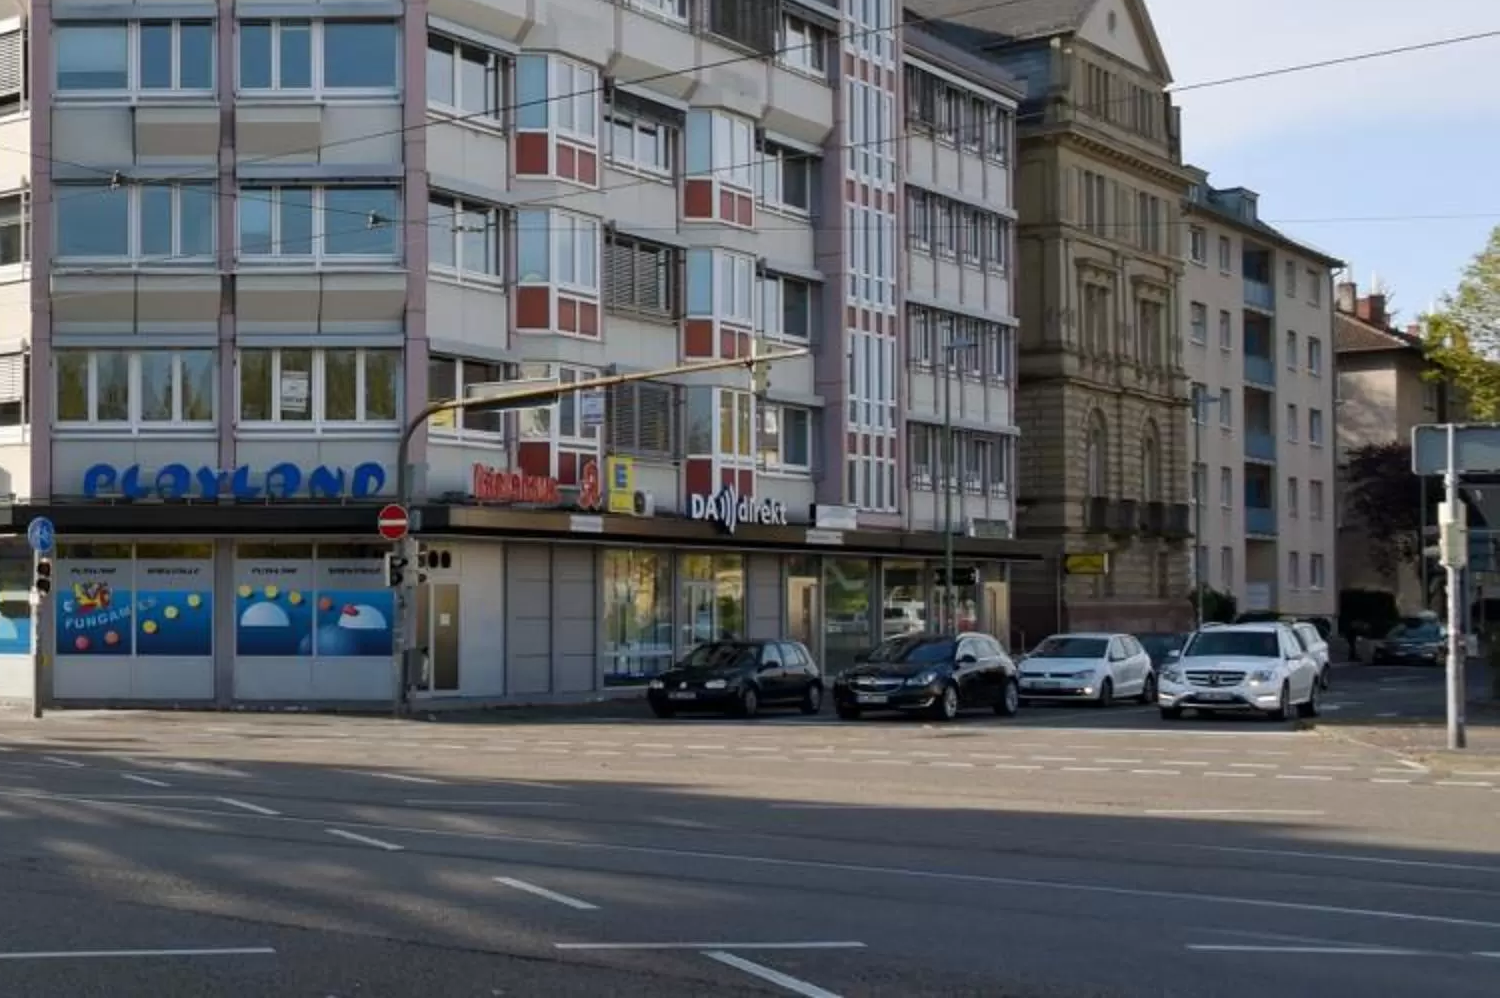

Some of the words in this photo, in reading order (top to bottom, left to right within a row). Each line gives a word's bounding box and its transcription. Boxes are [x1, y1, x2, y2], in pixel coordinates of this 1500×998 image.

[83, 462, 385, 500] PLAYLAND
[691, 493, 718, 520] DA
[738, 495, 787, 525] direkt
